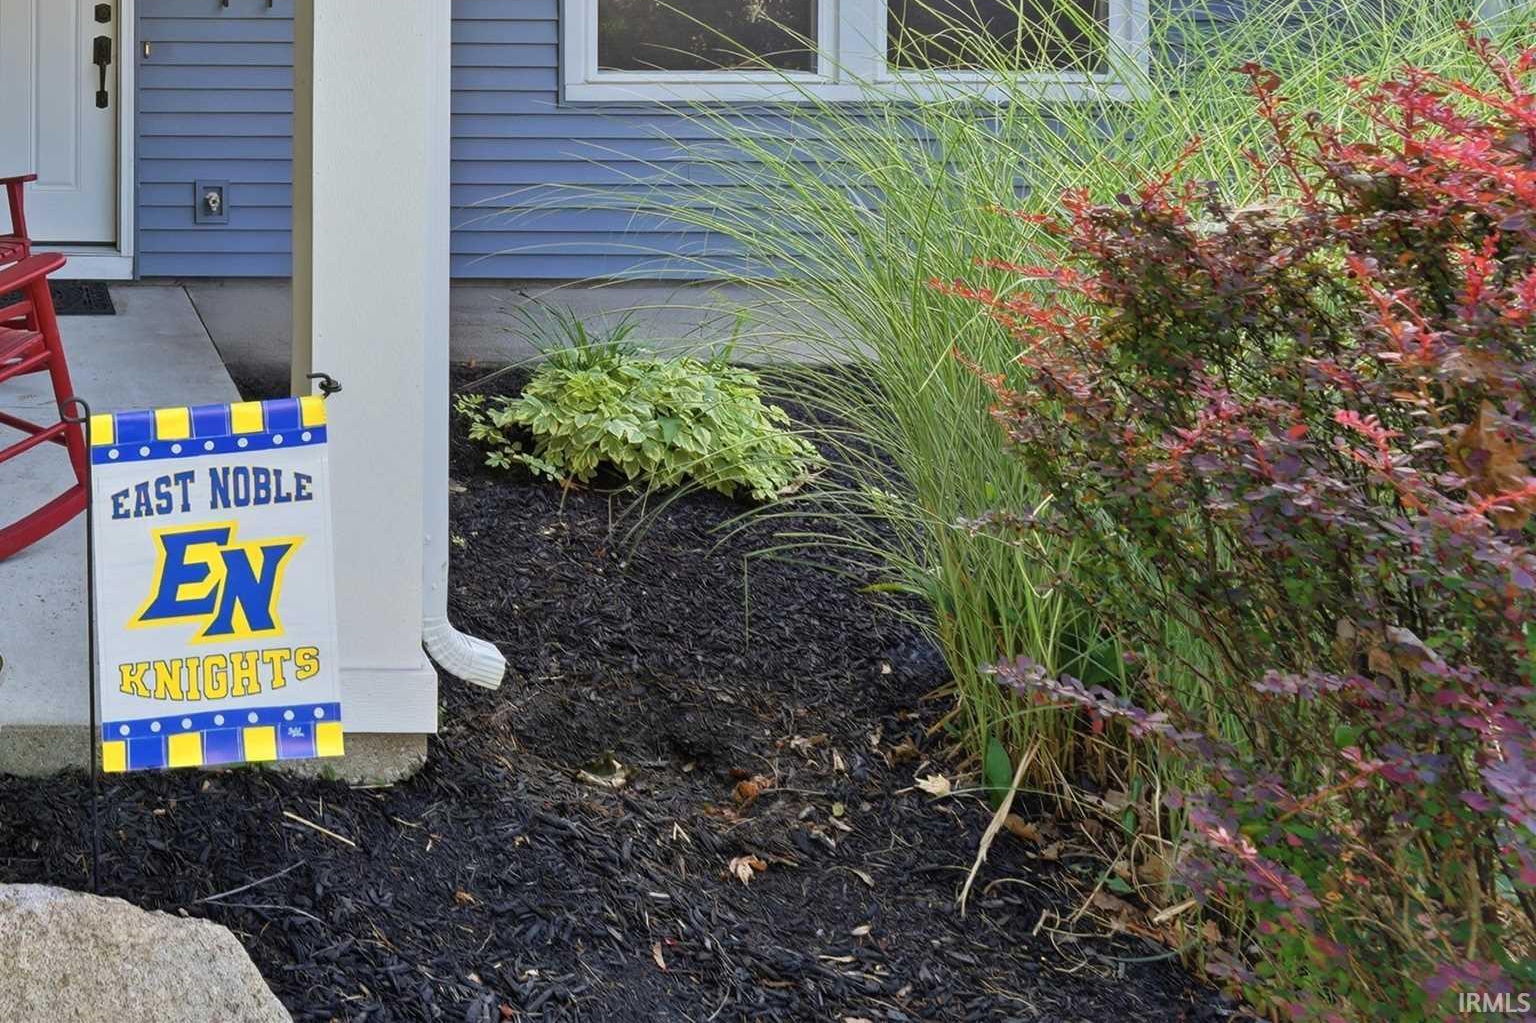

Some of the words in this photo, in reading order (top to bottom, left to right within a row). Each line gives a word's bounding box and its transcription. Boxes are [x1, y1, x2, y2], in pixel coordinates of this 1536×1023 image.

[111, 470, 195, 520] EAST
[208, 466, 313, 509] NOBLE
[134, 525, 296, 638] EN
[119, 646, 321, 701] KNIGHTS
